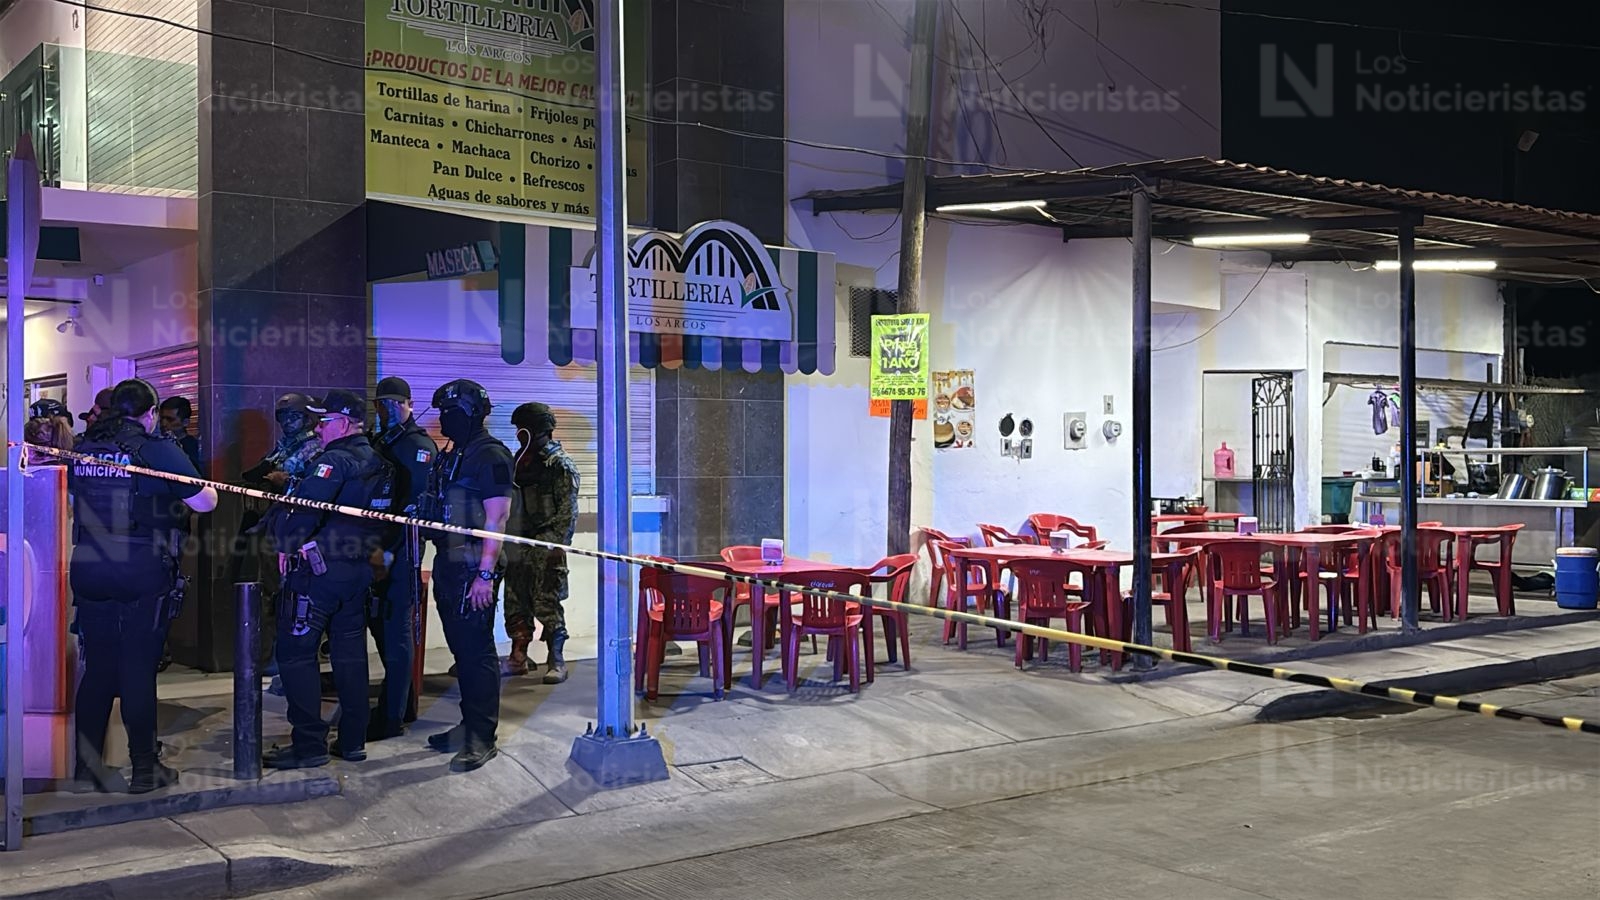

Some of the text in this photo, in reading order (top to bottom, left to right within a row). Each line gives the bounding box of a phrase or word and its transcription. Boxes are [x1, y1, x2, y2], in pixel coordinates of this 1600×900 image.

[446, 40, 532, 65] LOS ARCOS
[471, 66, 491, 84] DE
[495, 70, 514, 87] LA
[519, 73, 565, 96] MEJOR
[377, 82, 579, 125] Tortillas de harina Frijoles
[384, 107, 444, 128] Carnitas
[465, 119, 555, 144] Chicharrones
[370, 129, 580, 170] Manteca Machaca Chorizo
[433, 160, 585, 193] Pan Dulce Refrescos
[427, 184, 590, 215] Aguas de sabores y más
[426, 245, 480, 277] MASECA
[589, 272, 733, 306] TRTILLERIA
[636, 316, 706, 330] LOS ARCOS
[73, 465, 132, 478] MUNICIPAL
